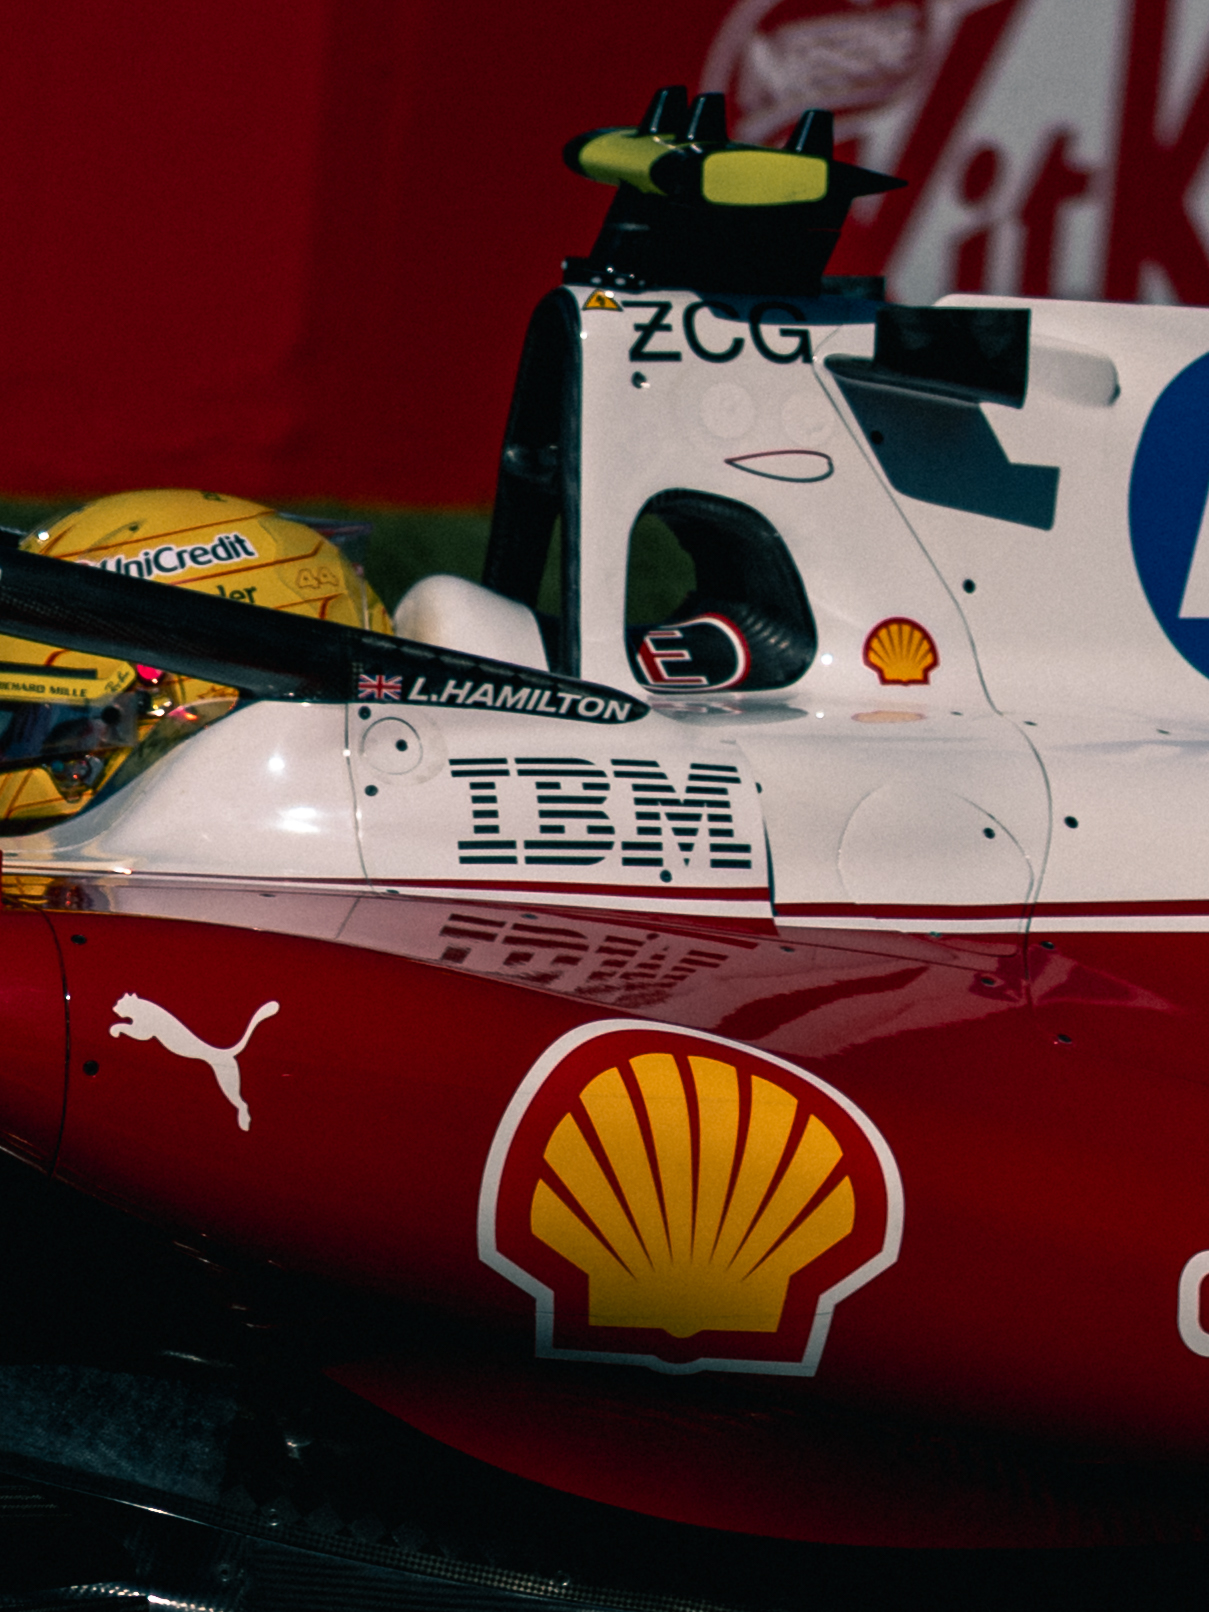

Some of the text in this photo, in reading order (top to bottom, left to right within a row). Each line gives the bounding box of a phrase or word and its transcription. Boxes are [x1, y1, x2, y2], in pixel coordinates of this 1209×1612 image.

[49, 685, 89, 698] MILLE
[407, 677, 632, 722] L.HAMILTON
[448, 756, 753, 870] IBM
